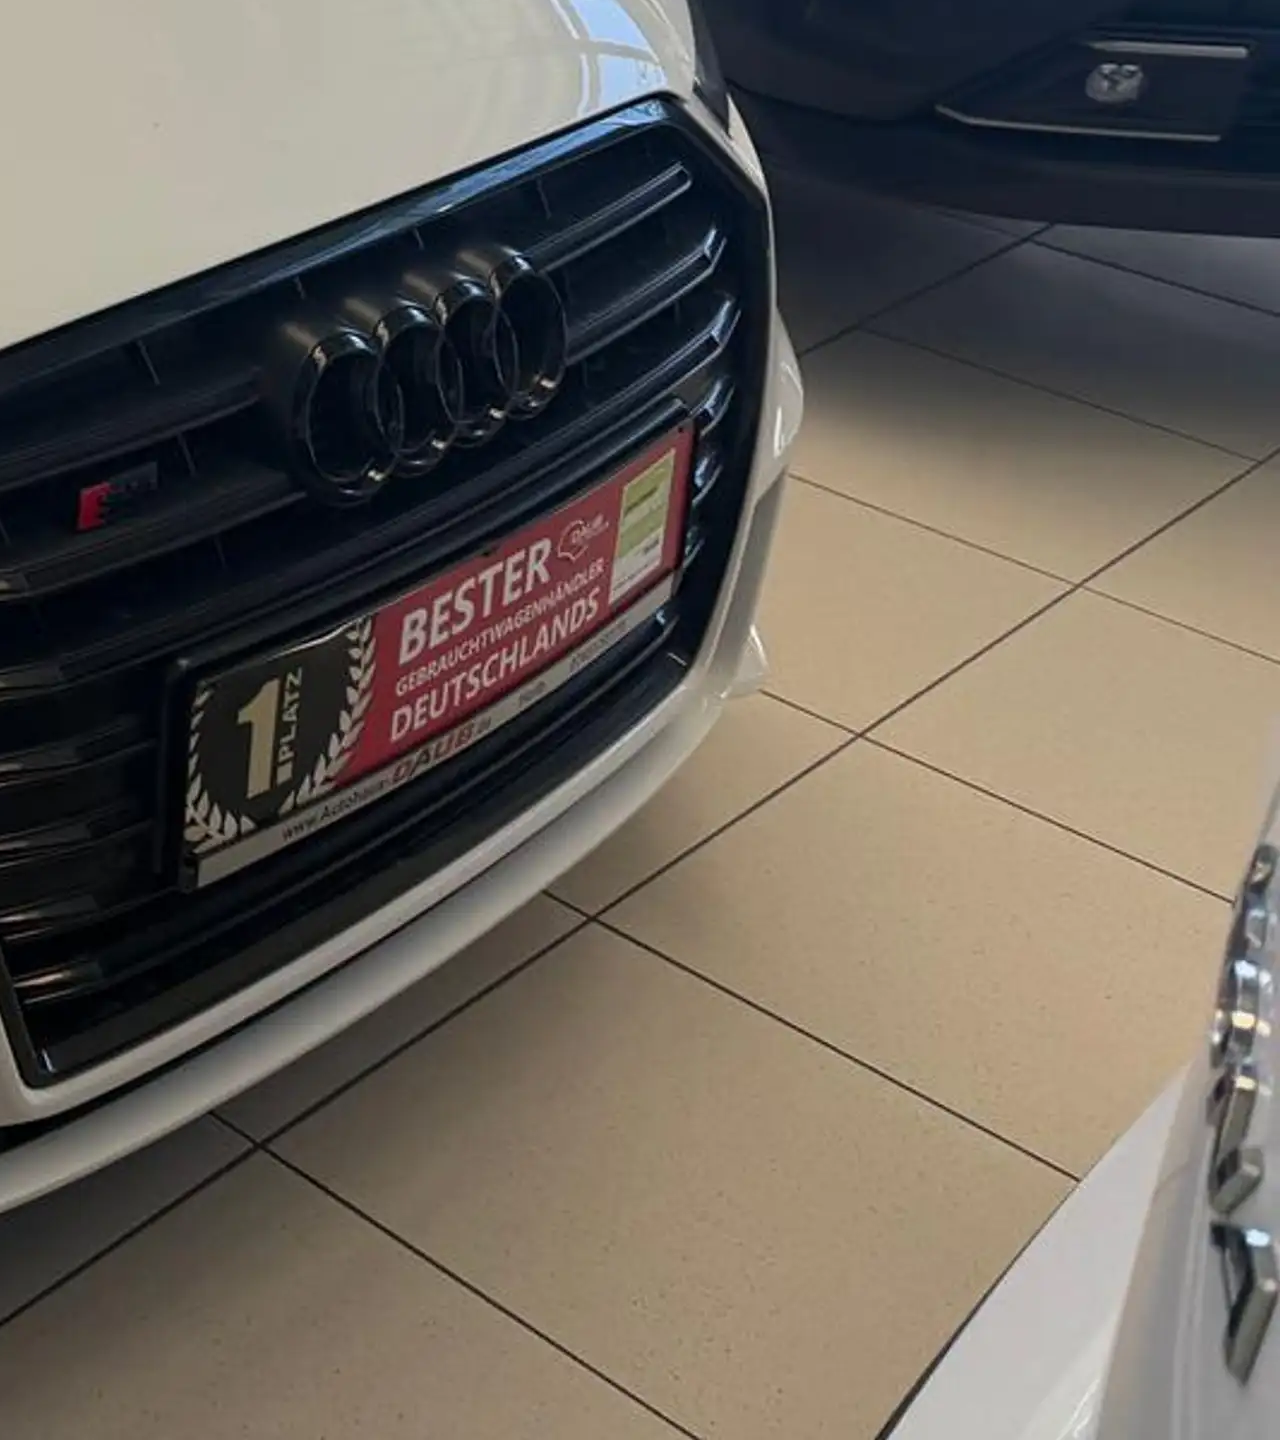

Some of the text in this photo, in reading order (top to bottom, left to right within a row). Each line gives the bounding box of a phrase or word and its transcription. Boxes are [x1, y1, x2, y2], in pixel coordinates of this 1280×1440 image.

[390, 587, 601, 743] DEUTSCHLANDS
[396, 557, 607, 697] GEBRAUCHTWAGENHÄNDLER
[398, 537, 552, 667] BESTER
[277, 666, 303, 763] PLATZ
